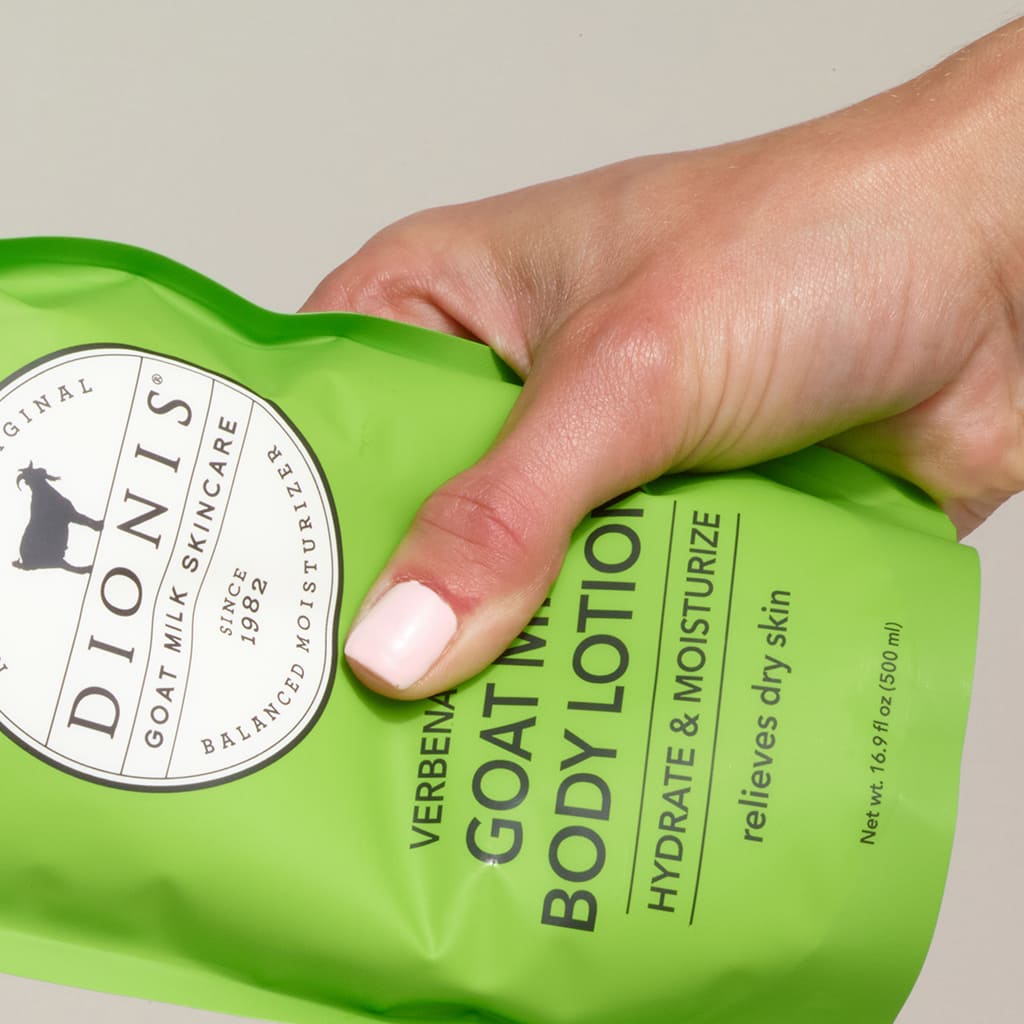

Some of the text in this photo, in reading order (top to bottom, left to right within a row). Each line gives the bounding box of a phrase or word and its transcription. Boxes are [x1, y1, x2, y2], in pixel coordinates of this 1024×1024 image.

[144, 416, 238, 749] GOAT MILK SKINCARE
[201, 444, 319, 755] BALANCED MOISTURIZER
[220, 567, 248, 636] SINCE
[241, 577, 268, 646] 1982
[466, 683, 538, 866] GOAT
[647, 510, 721, 912] HYDRATE & MOISTURIZE
[738, 589, 792, 843] relieves dry skin
[859, 621, 903, 845] Net wt. 16.9 fl oz (500 ml)
[541, 728, 618, 932] BODY
